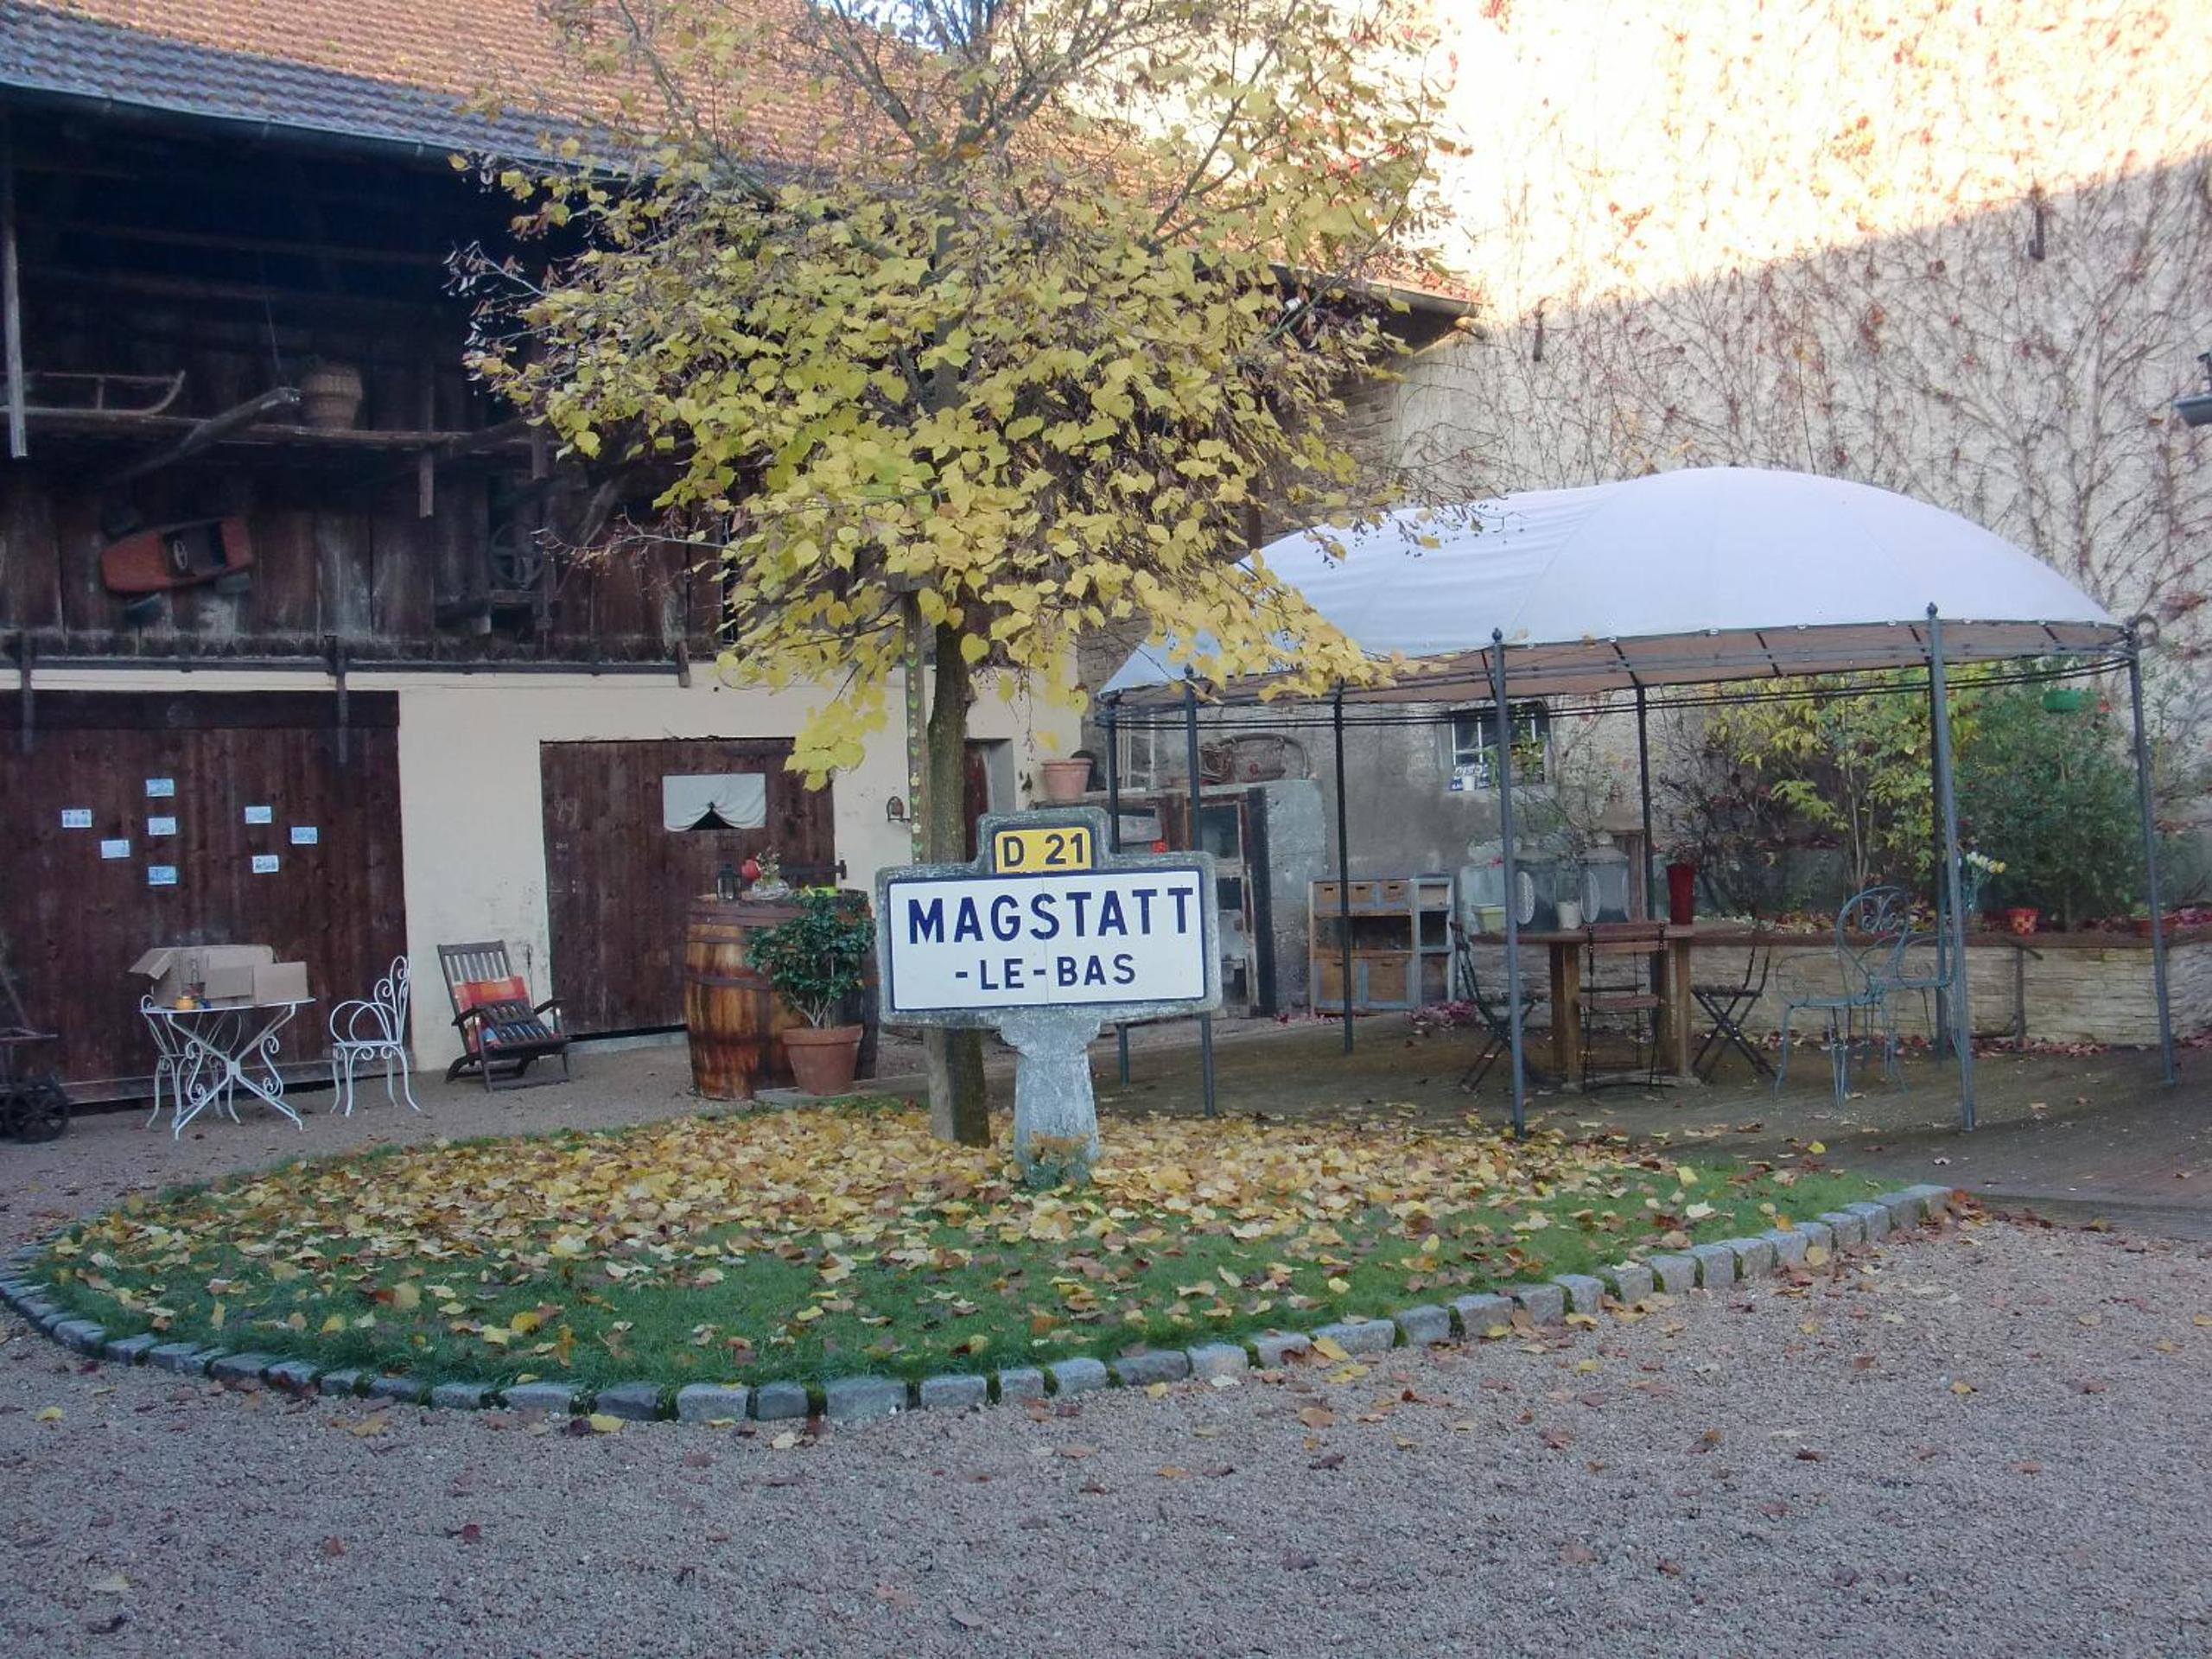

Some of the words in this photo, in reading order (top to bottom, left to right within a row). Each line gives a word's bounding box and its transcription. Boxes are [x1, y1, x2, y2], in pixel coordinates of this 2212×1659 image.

[1003, 836, 1025, 868] D
[1045, 833, 1084, 865] 21
[908, 887, 1193, 944] MAGSTATT
[955, 954, 1136, 990] -LE-BAS
